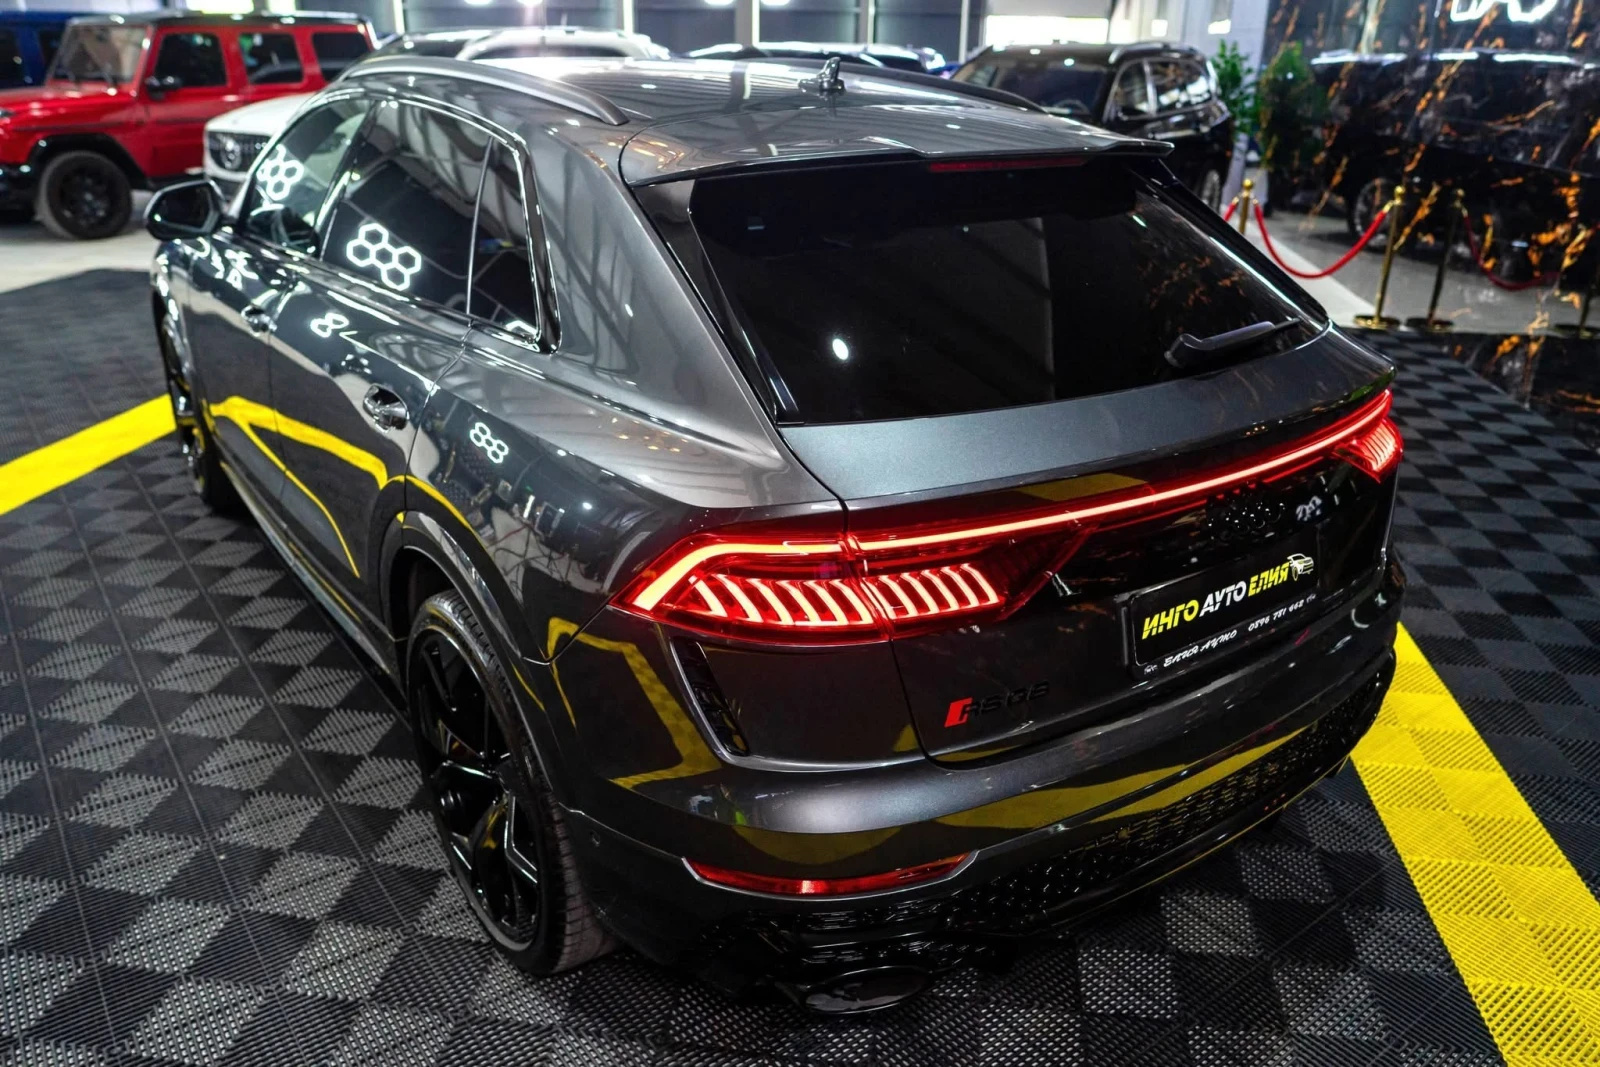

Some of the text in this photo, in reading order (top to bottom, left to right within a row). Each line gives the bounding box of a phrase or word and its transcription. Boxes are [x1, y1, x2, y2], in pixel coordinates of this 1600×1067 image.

[1142, 562, 1290, 640] ИНГО АУТО ЕЛИЯ
